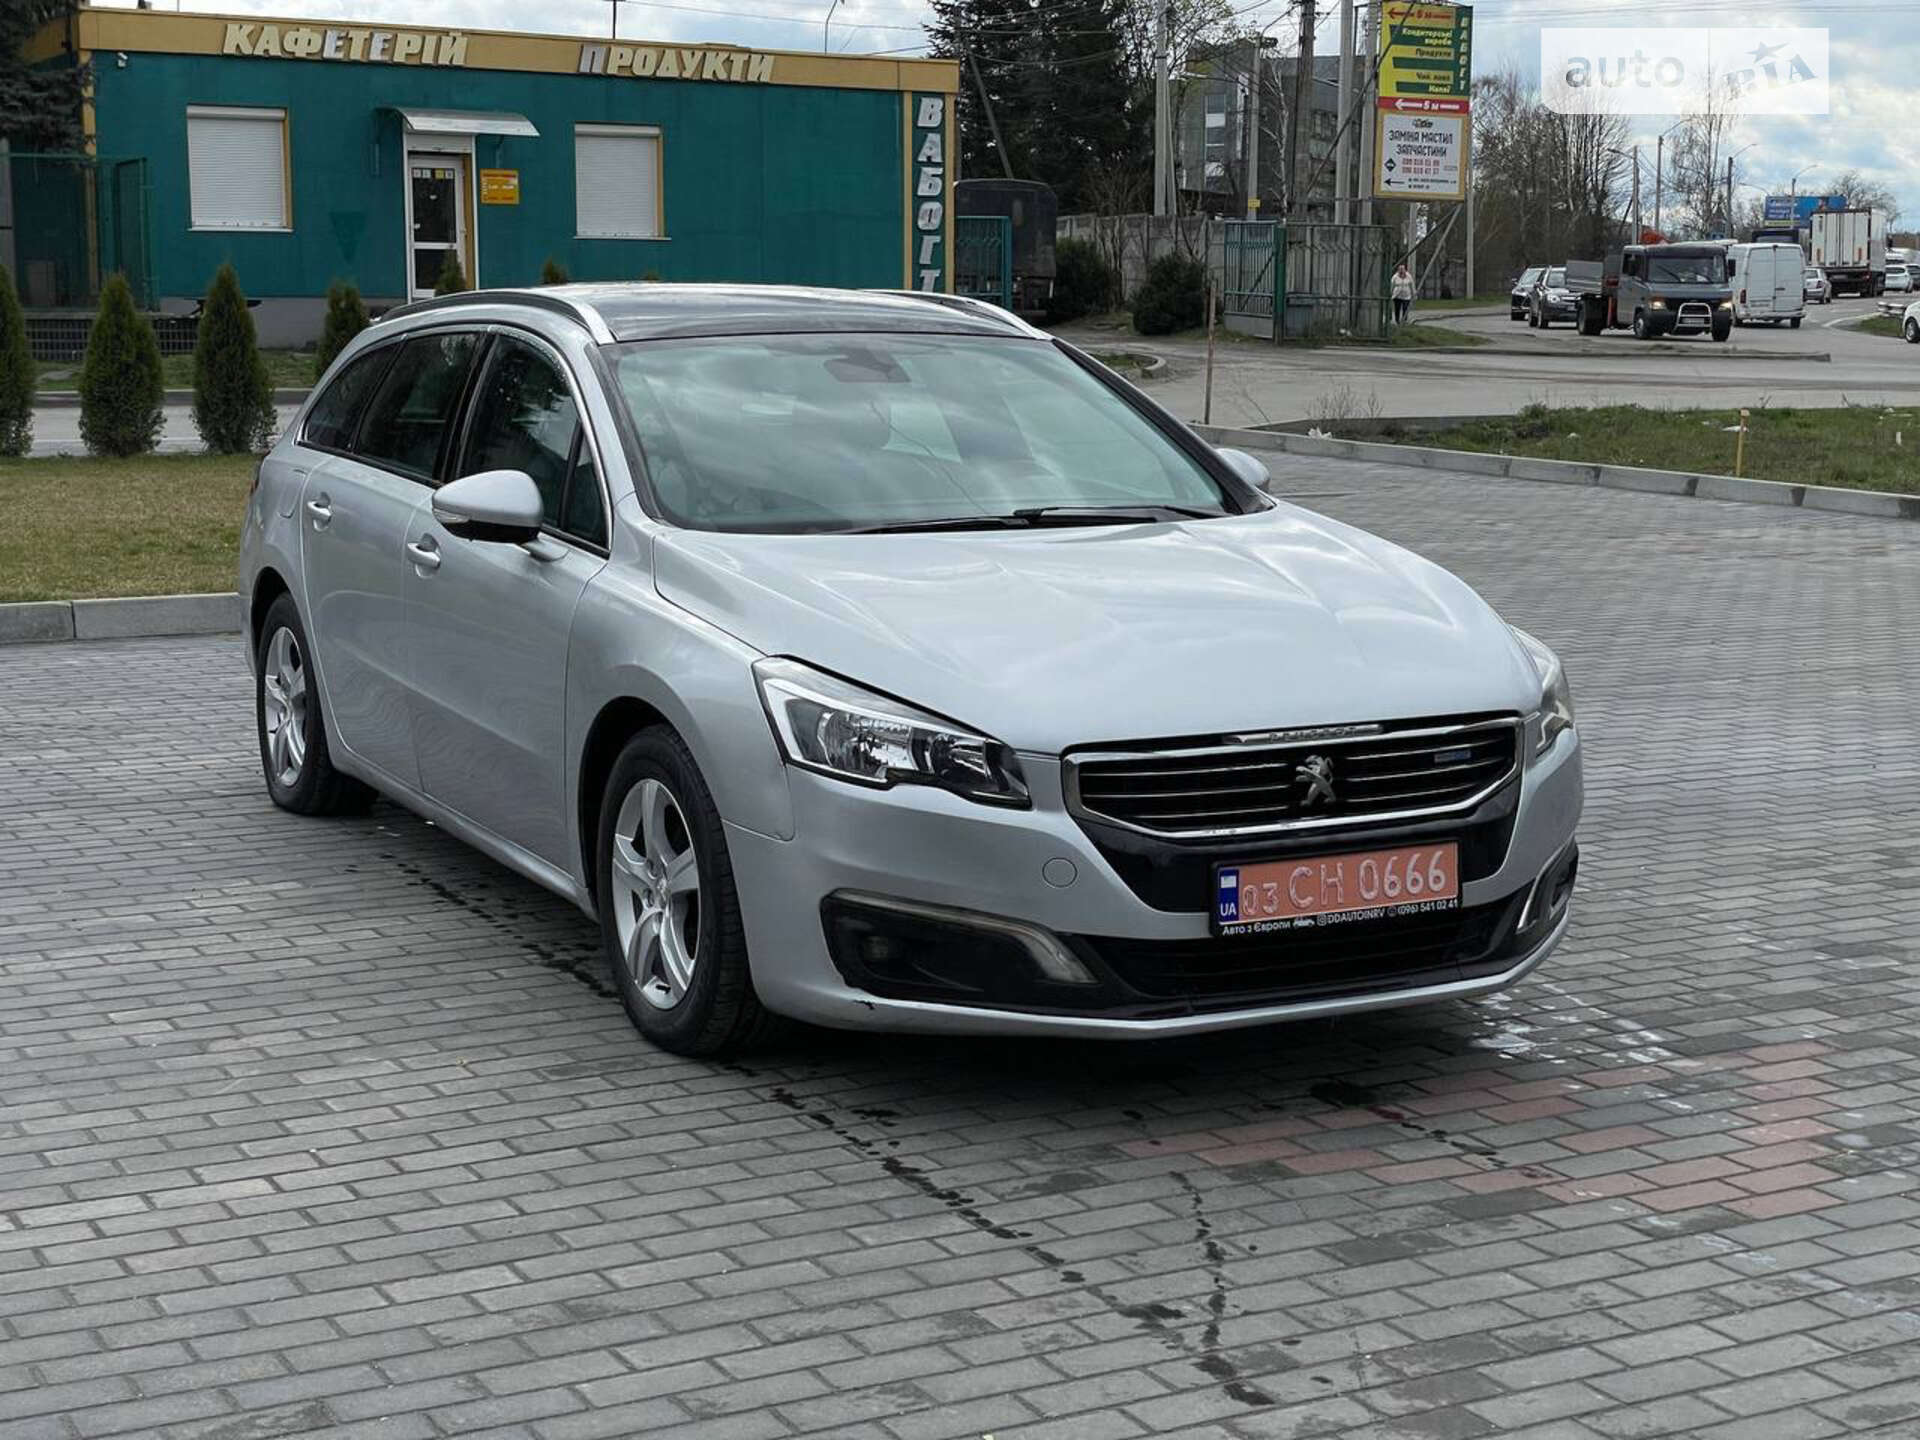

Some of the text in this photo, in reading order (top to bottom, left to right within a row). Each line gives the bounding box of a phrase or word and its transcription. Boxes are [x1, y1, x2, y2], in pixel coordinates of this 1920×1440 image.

[223, 23, 468, 65] КАФЕТЕРІЙ
[579, 43, 774, 83] ПРОДУКТИ
[1389, 130, 1453, 145] ЗАМІНА МАСТИЛ
[1396, 143, 1447, 158] ЗАПЧАСТИНИ
[1242, 882, 1280, 915] 03
[1358, 850, 1447, 902] 0666
[1220, 903, 1237, 917] UA
[1222, 924, 1246, 936] Авто
[1254, 920, 1291, 933] Європи
